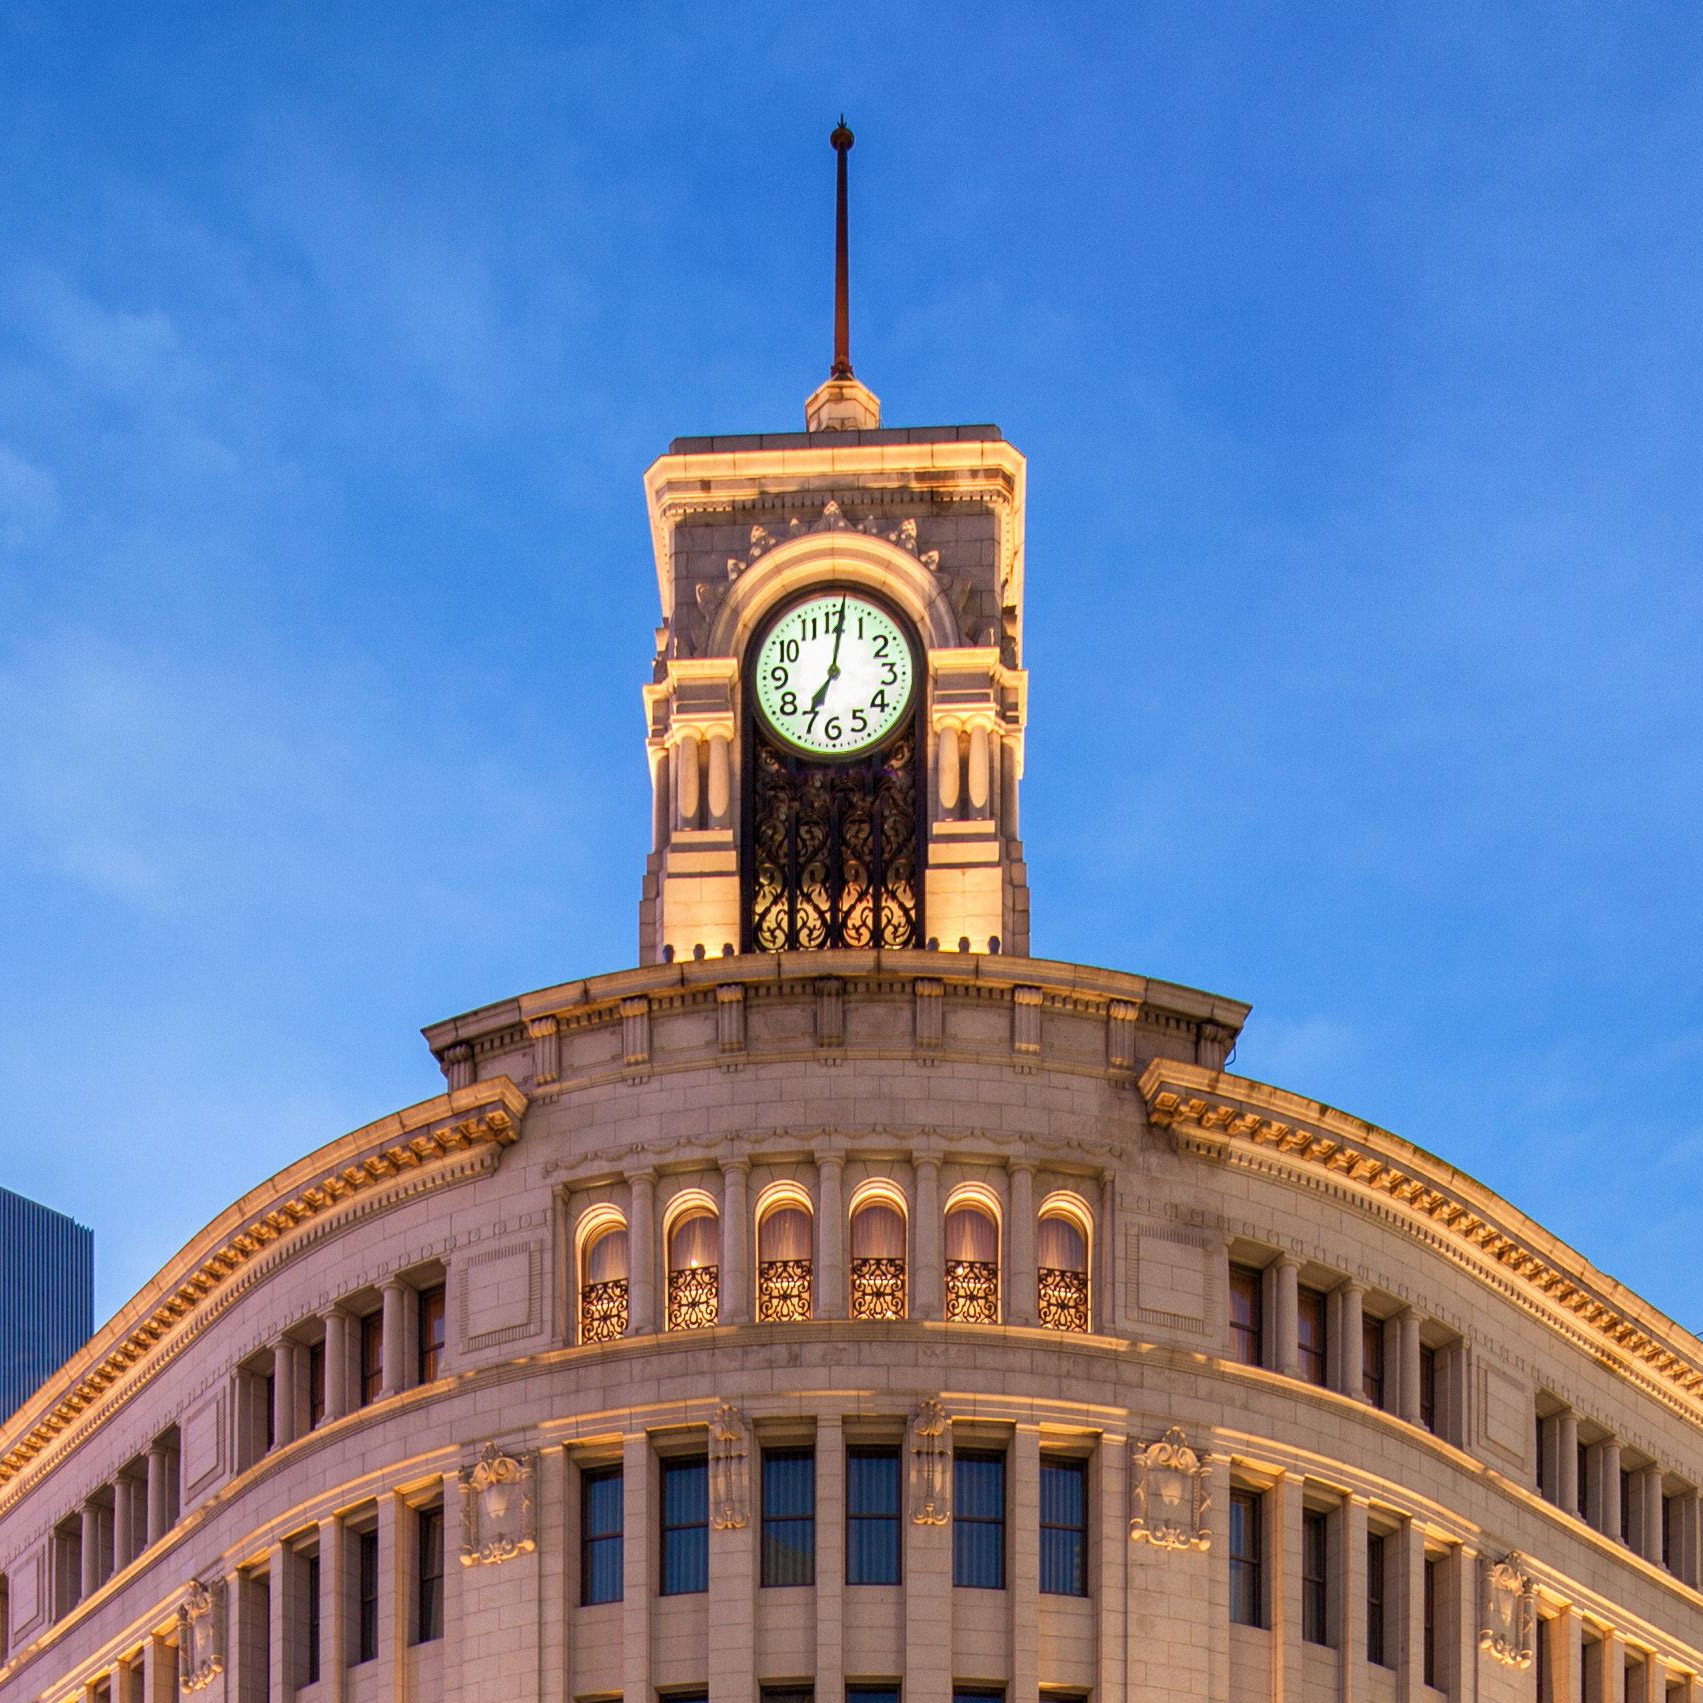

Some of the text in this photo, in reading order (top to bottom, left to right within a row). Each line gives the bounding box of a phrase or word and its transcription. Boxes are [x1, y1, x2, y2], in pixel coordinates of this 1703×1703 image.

[800, 617, 817, 641] 11
[824, 610, 846, 634] 12
[857, 617, 864, 640] 1
[779, 639, 800, 663] 10
[873, 635, 889, 658] 2
[770, 666, 789, 690] 9
[881, 662, 897, 685] 3
[779, 691, 798, 716] 8
[870, 689, 889, 713] 4
[802, 710, 819, 734] 7
[824, 717, 842, 741] 6
[851, 710, 868, 733] 5
